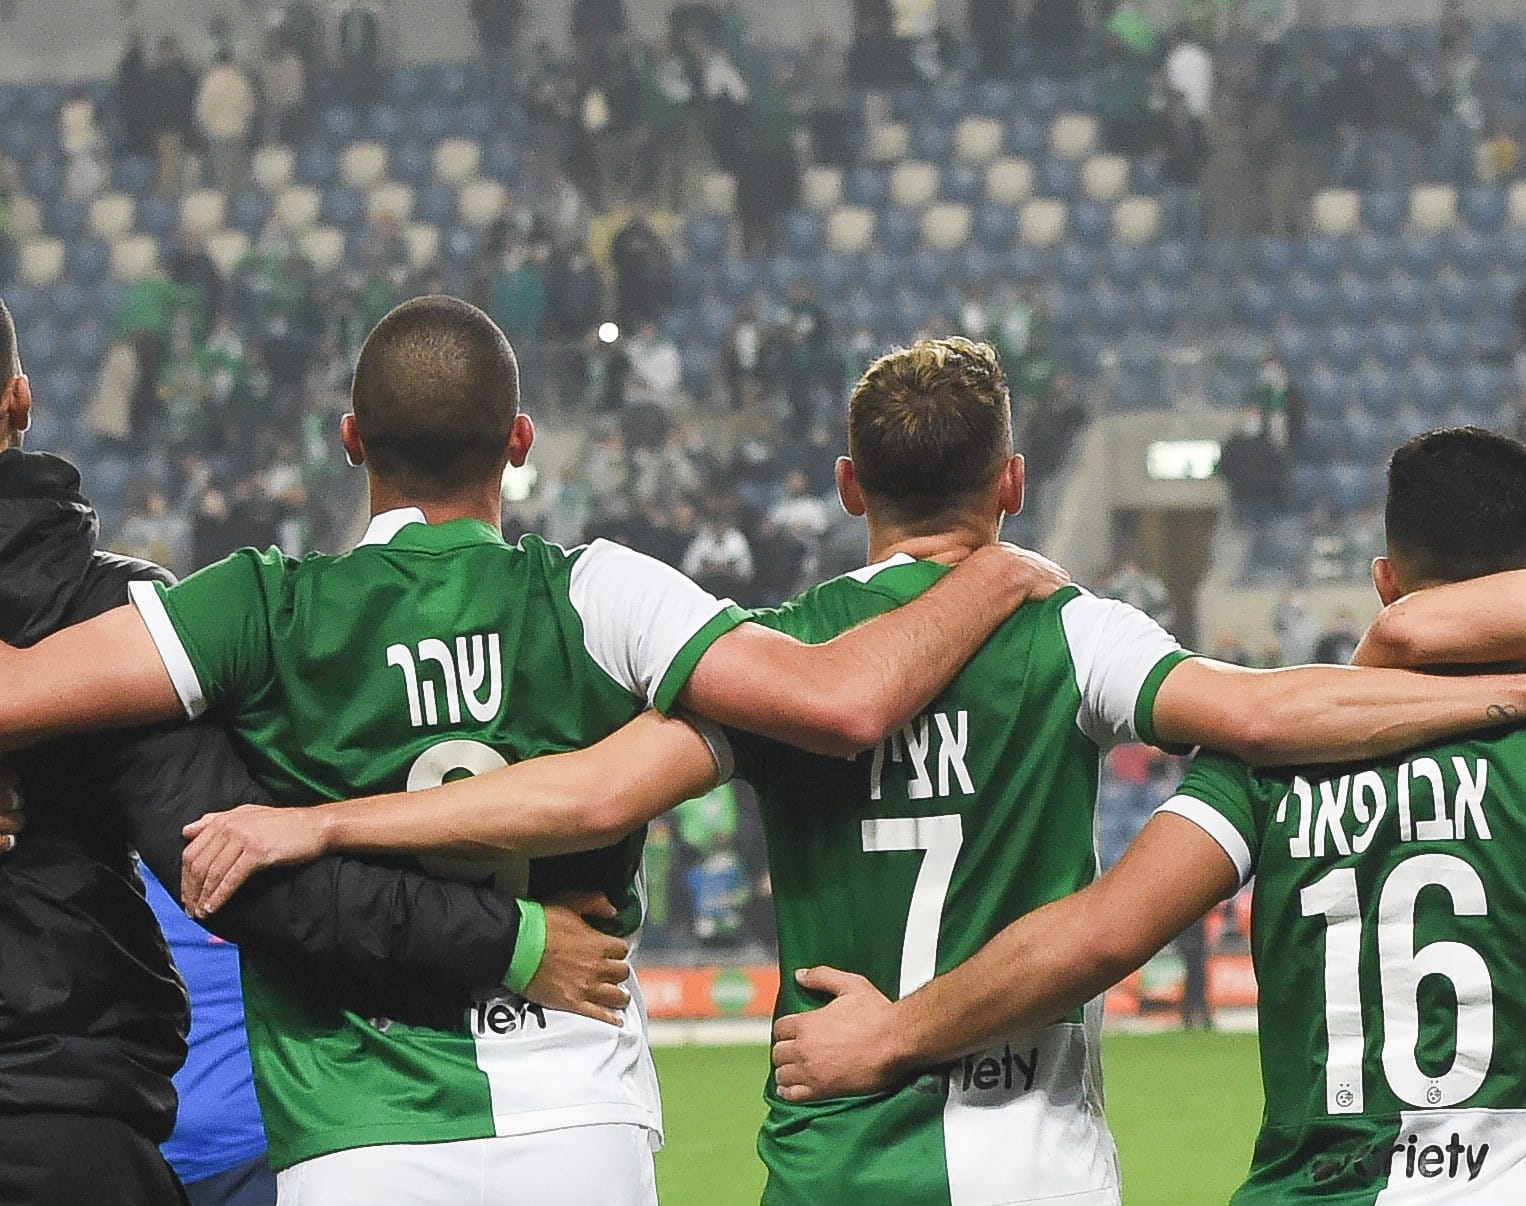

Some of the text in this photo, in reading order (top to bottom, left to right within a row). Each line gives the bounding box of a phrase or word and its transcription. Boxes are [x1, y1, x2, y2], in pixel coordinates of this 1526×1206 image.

[386, 633, 503, 727] שהר
[1275, 756, 1492, 859] אבו פאני
[861, 814, 963, 1001] 7
[1300, 853, 1495, 1115] 16
